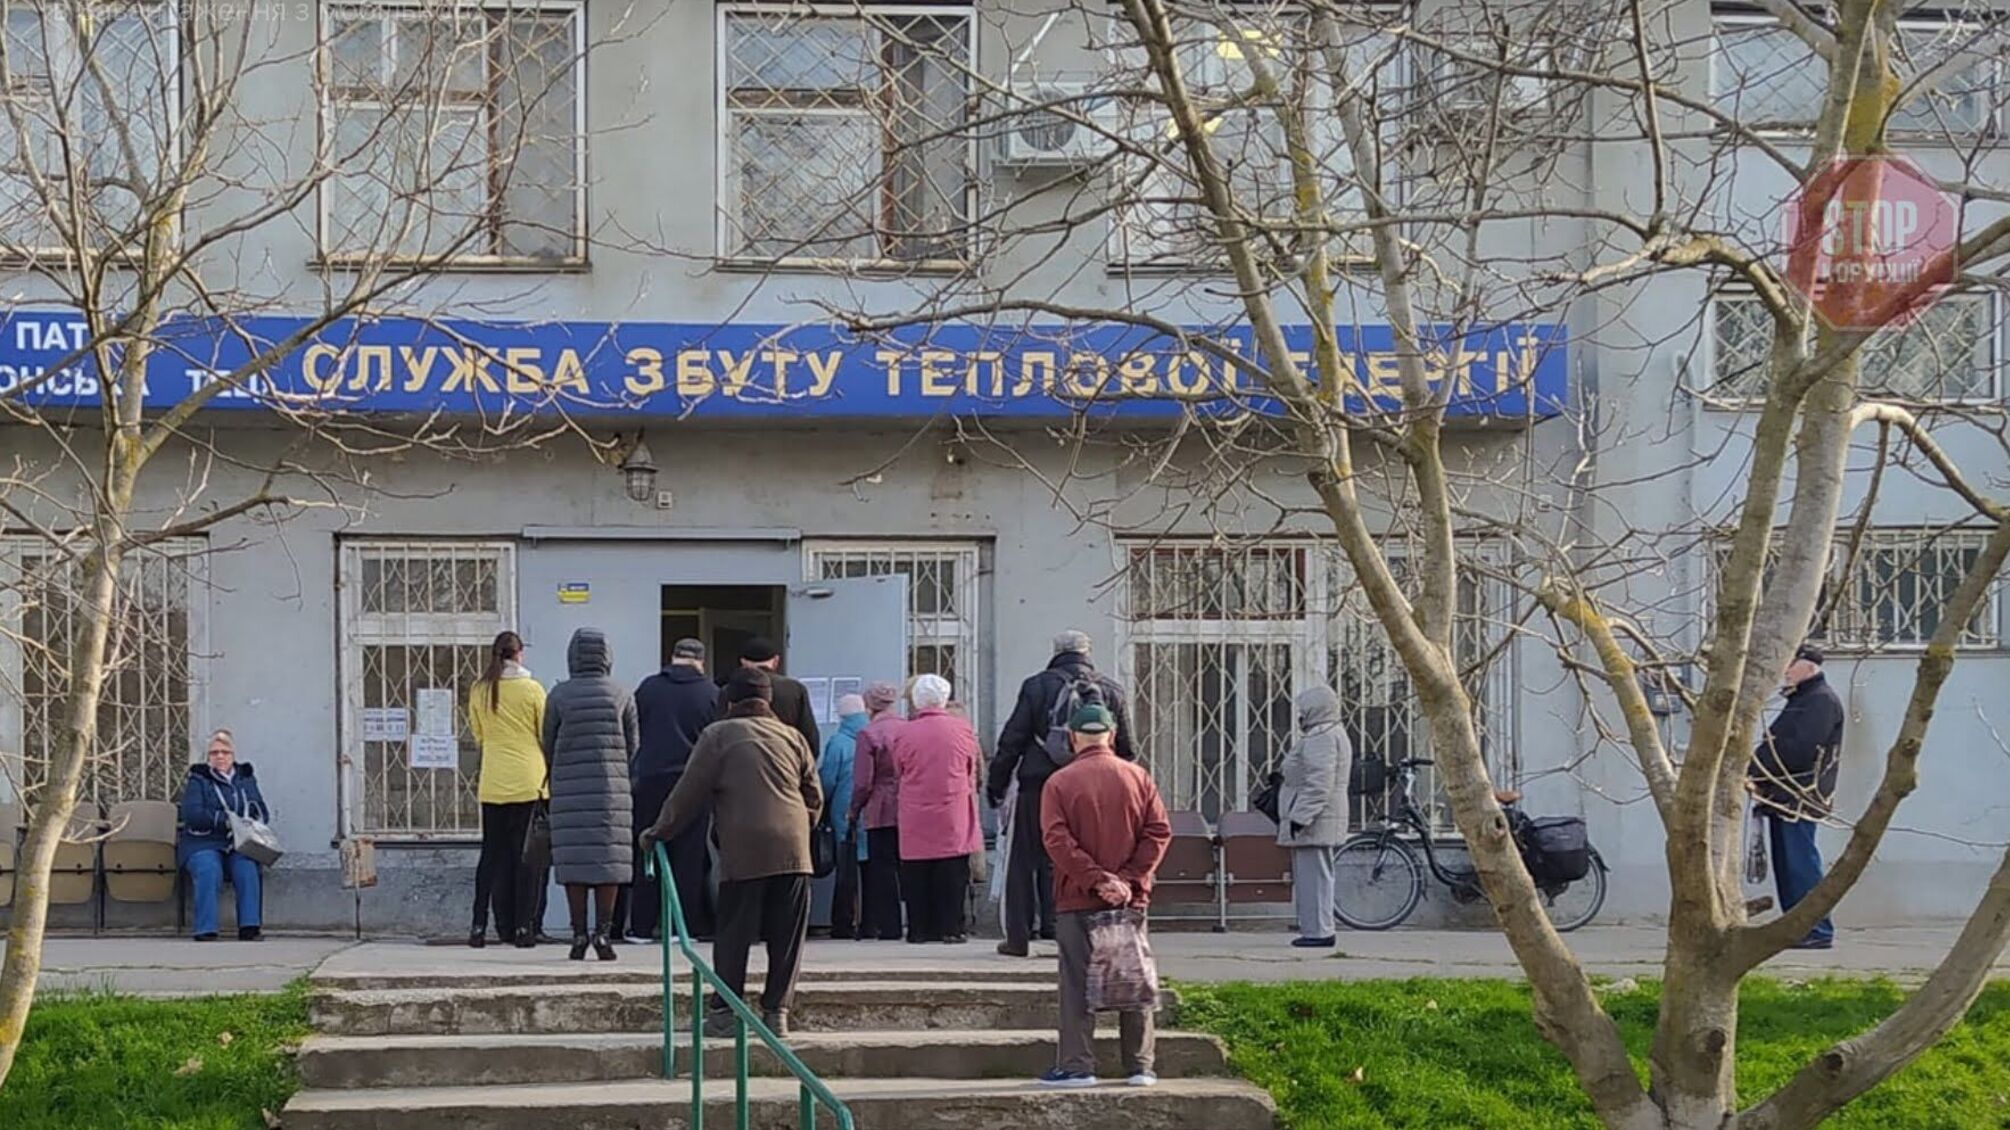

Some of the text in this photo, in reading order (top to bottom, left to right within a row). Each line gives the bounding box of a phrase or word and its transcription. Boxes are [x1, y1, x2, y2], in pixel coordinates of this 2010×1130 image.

[16, 321, 88, 350] ПАТ
[0, 364, 150, 397] ОНСЬ
[302, 343, 591, 395] СЛУЖБА
[623, 347, 844, 397] ЗБУТУ
[875, 338, 1242, 397] ТЕПЛОВОЇ
